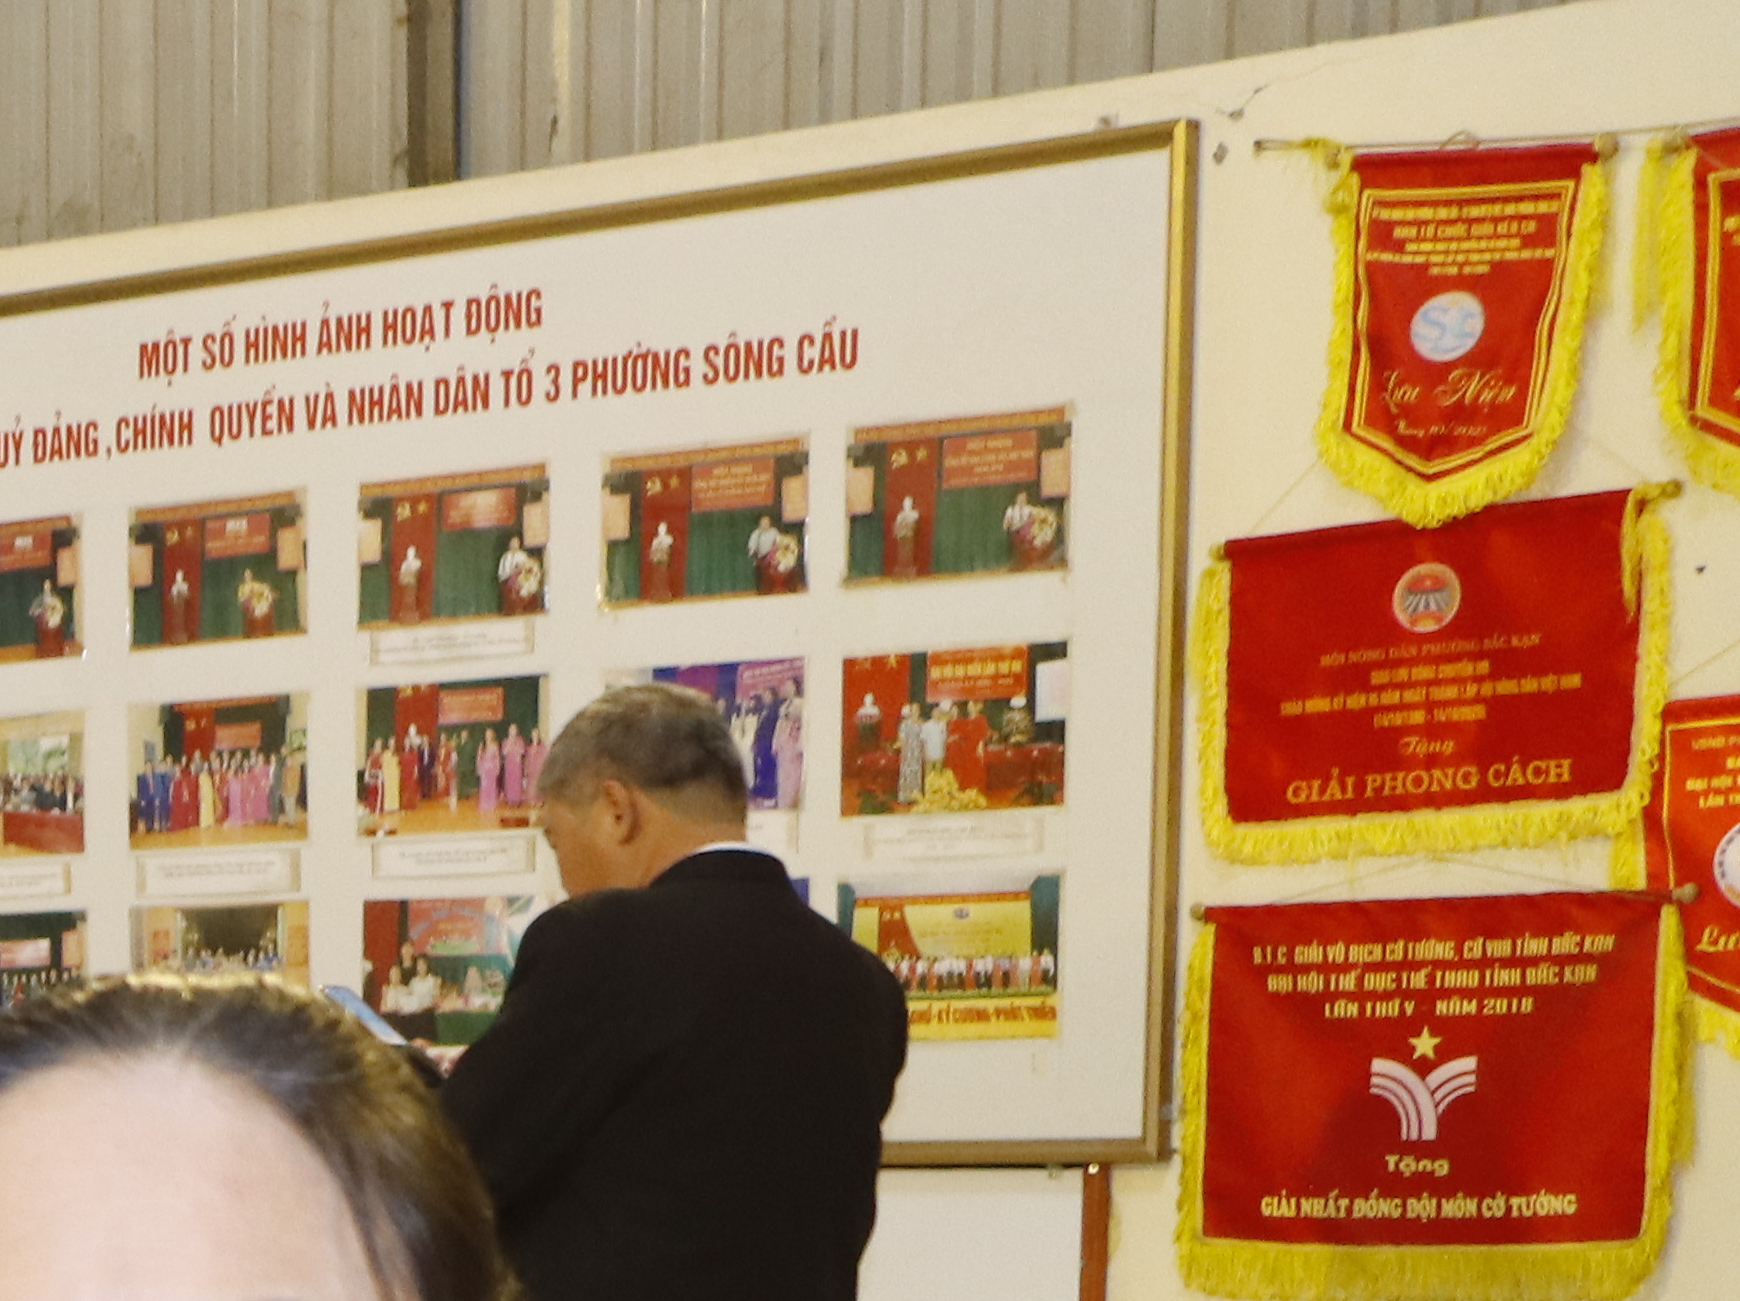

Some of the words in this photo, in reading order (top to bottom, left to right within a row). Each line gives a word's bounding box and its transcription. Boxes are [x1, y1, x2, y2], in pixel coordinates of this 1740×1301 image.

[138, 329, 192, 387] MỘT
[202, 314, 237, 371] SỐ
[244, 315, 306, 365] HÌNH
[316, 301, 372, 356] ẢNH
[382, 300, 455, 353] HOẠT
[465, 284, 544, 344] ĐỘNG
[31, 410, 99, 465] ĐẢNG
[305, 381, 338, 432] VÀ
[347, 374, 425, 427] NHÂN
[433, 364, 490, 417] DÂN
[501, 347, 536, 409] TỔ
[544, 363, 561, 403] 3
[571, 340, 691, 399] PHƯỜNG
[702, 331, 785, 386] SÔNG
[1287, 767, 1355, 804] GIẢI
[1365, 767, 1479, 798] PHONG
[1488, 756, 1572, 787] CÁCH
[1385, 1153, 1450, 1177] Tặng
[1260, 1188, 1298, 1218] GIẢI
[1300, 1188, 1351, 1218] NHẤT
[1406, 1191, 1437, 1223] ĐỘI
[1440, 1191, 1478, 1218] MÔN
[1509, 1188, 1577, 1217] TƯỚNG
